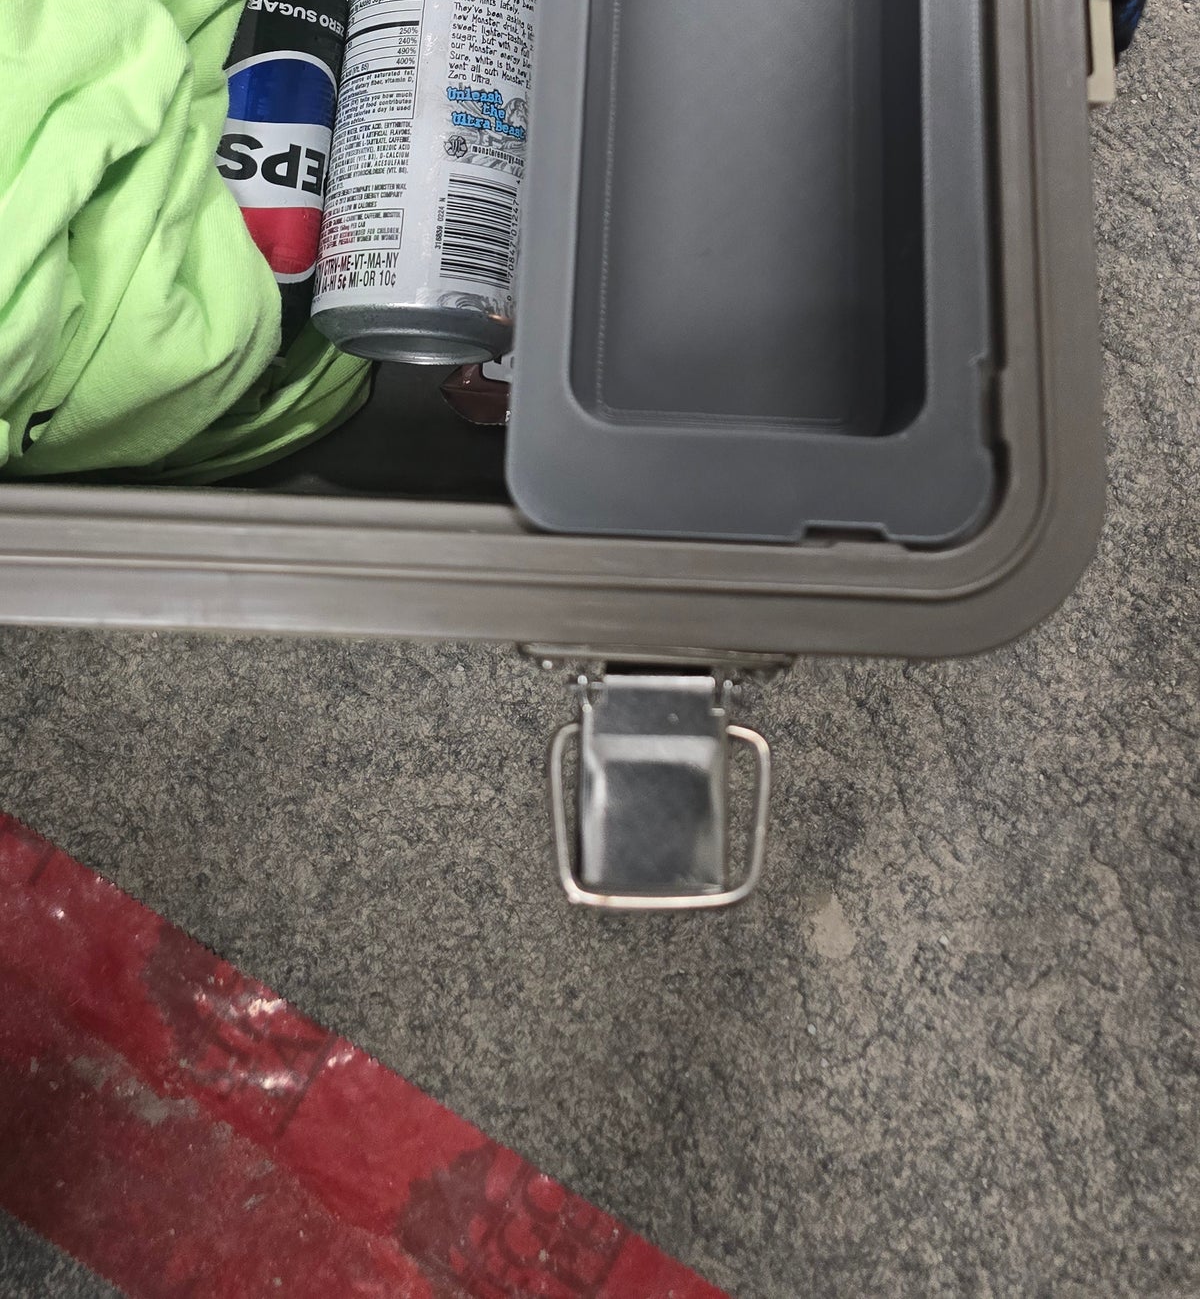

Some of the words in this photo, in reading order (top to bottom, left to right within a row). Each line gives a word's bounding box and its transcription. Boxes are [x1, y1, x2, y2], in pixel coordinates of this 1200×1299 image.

[454, 2, 482, 13] They've
[486, 7, 503, 19] been
[319, 14, 345, 37] ZERO
[472, 14, 500, 27] Monster
[452, 33, 477, 42] sugar,
[482, 35, 496, 45] but
[450, 50, 470, 62] Sure,
[469, 42, 497, 55] Monster
[449, 62, 468, 71] went
[471, 64, 480, 74] all
[448, 70, 467, 80] Zero
[471, 73, 492, 85] Ultra.
[447, 86, 503, 105] Unleash
[481, 102, 506, 120] the
[451, 111, 492, 130] Ultra
[494, 118, 526, 140] Beast
[374, 159, 408, 167] ACESULFAME
[472, 145, 524, 166] monsterenergy.com
[216, 133, 326, 196] EPS
[436, 206, 445, 222] 0224
[510, 199, 520, 236] 01247
[506, 241, 516, 278] 70847
[349, 270, 375, 288] MI-OR
[380, 270, 397, 288] 10¢
